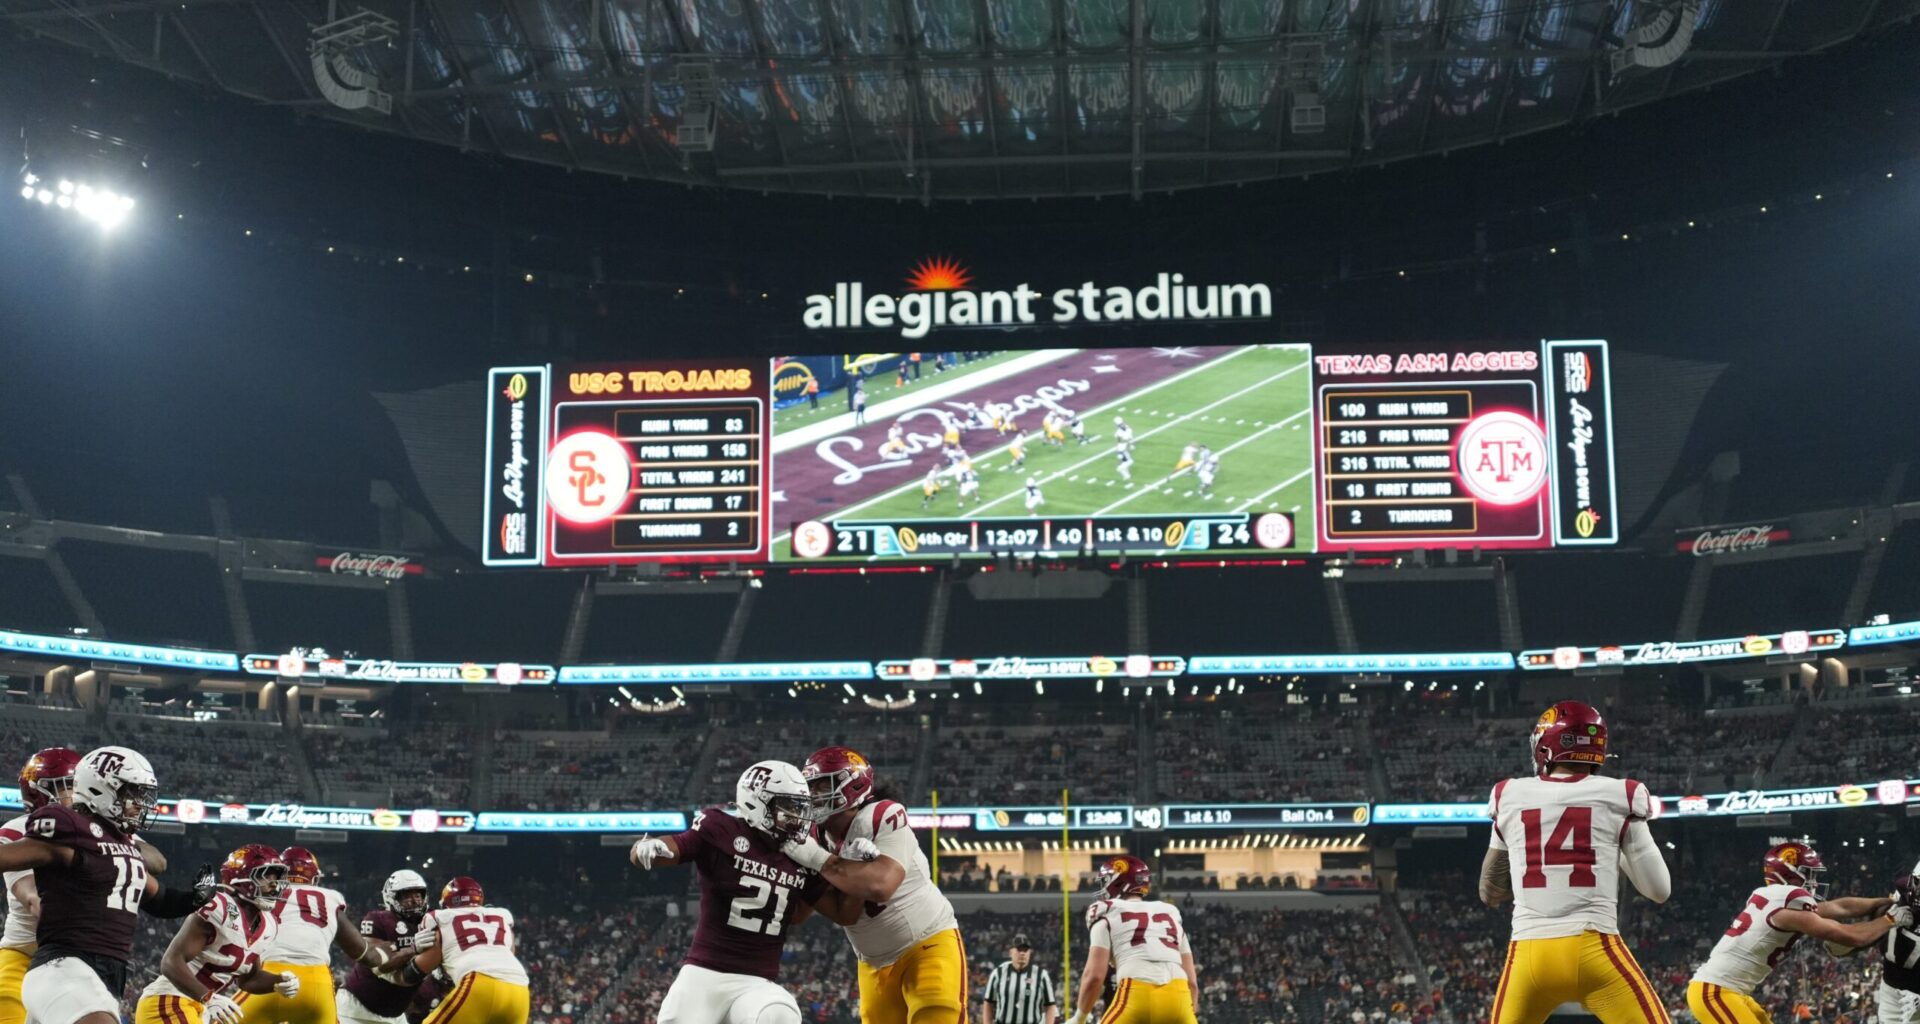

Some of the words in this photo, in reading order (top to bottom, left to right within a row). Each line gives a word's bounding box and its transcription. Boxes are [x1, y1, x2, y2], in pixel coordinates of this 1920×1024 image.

[802, 282, 1036, 338] allegiant
[1053, 273, 1272, 321] stadium
[1315, 354, 1392, 375] TEXAS
[1395, 353, 1448, 373] A&M
[1451, 351, 1537, 371] AGGIES
[570, 372, 623, 394] USC
[629, 369, 751, 392] TROJANS
[1339, 403, 1366, 417] 100
[510, 401, 523, 440] BOWL
[1340, 430, 1367, 444] 216
[1341, 456, 1368, 471] 316
[720, 469, 746, 482] 241
[1346, 484, 1365, 498] 18
[1576, 467, 1590, 508] BOWL
[724, 495, 742, 509] 17
[1351, 510, 1362, 524] 2
[728, 522, 739, 536] 2
[1056, 528, 1082, 544] 40
[1097, 528, 1122, 542] 1st
[1126, 528, 1140, 541] &
[1143, 528, 1163, 542] 10
[1217, 524, 1250, 544] 24
[837, 531, 867, 551] 21
[918, 532, 942, 546] 4th
[943, 532, 968, 547] Qtr
[985, 529, 1039, 545] 12:07
[1702, 641, 1744, 657] BOWL
[420, 666, 460, 679] BOWL
[1050, 661, 1090, 674] BOWL
[1570, 752, 1593, 761] FIGHT
[1791, 791, 1837, 806] BOWL
[329, 812, 372, 826] BOWL
[885, 809, 909, 832] 77
[1183, 810, 1202, 823] 1st
[1203, 810, 1214, 823] &
[1215, 810, 1232, 823] 10
[1281, 809, 1304, 822] Ball
[1306, 809, 1323, 821] On
[1324, 809, 1334, 821] 4
[1520, 806, 1597, 888] 14
[733, 855, 777, 882] TEXAS
[778, 873, 805, 891] A&M
[106, 857, 148, 915] 18
[727, 875, 790, 936] 21
[452, 913, 507, 952] 67
[1120, 911, 1180, 951] 73
